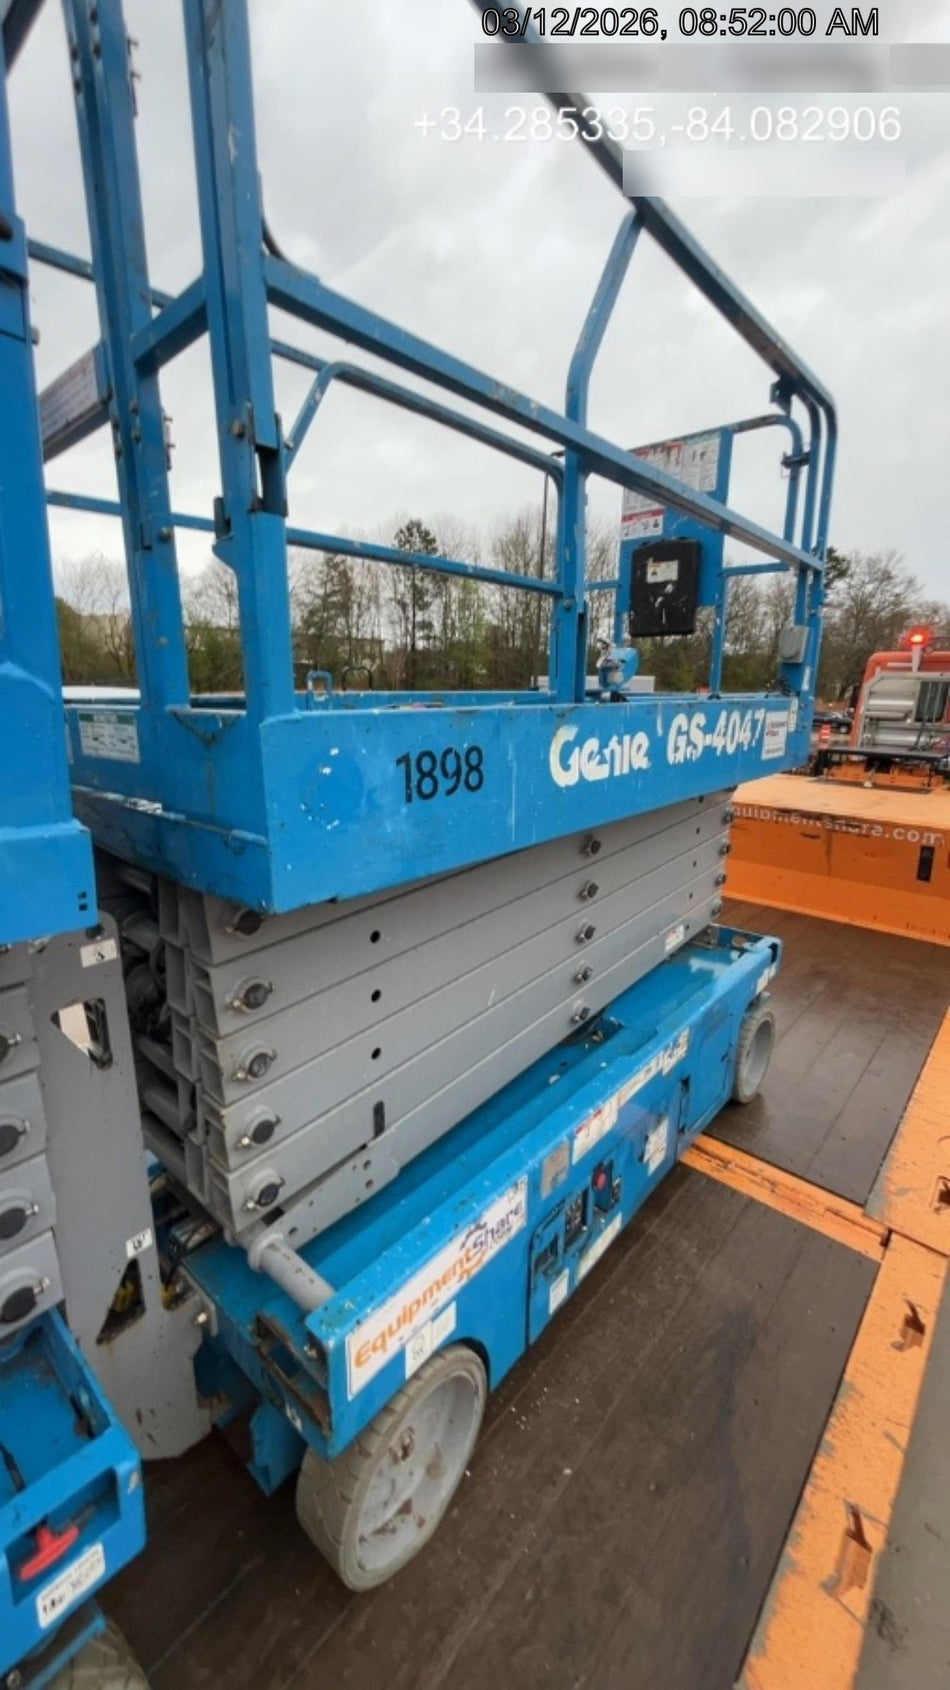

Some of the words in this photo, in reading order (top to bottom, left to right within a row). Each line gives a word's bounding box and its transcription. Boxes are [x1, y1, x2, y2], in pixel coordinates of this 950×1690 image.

[396, 745, 484, 804] 1898
[550, 724, 650, 788] Genie
[667, 708, 765, 765] GS-4047
